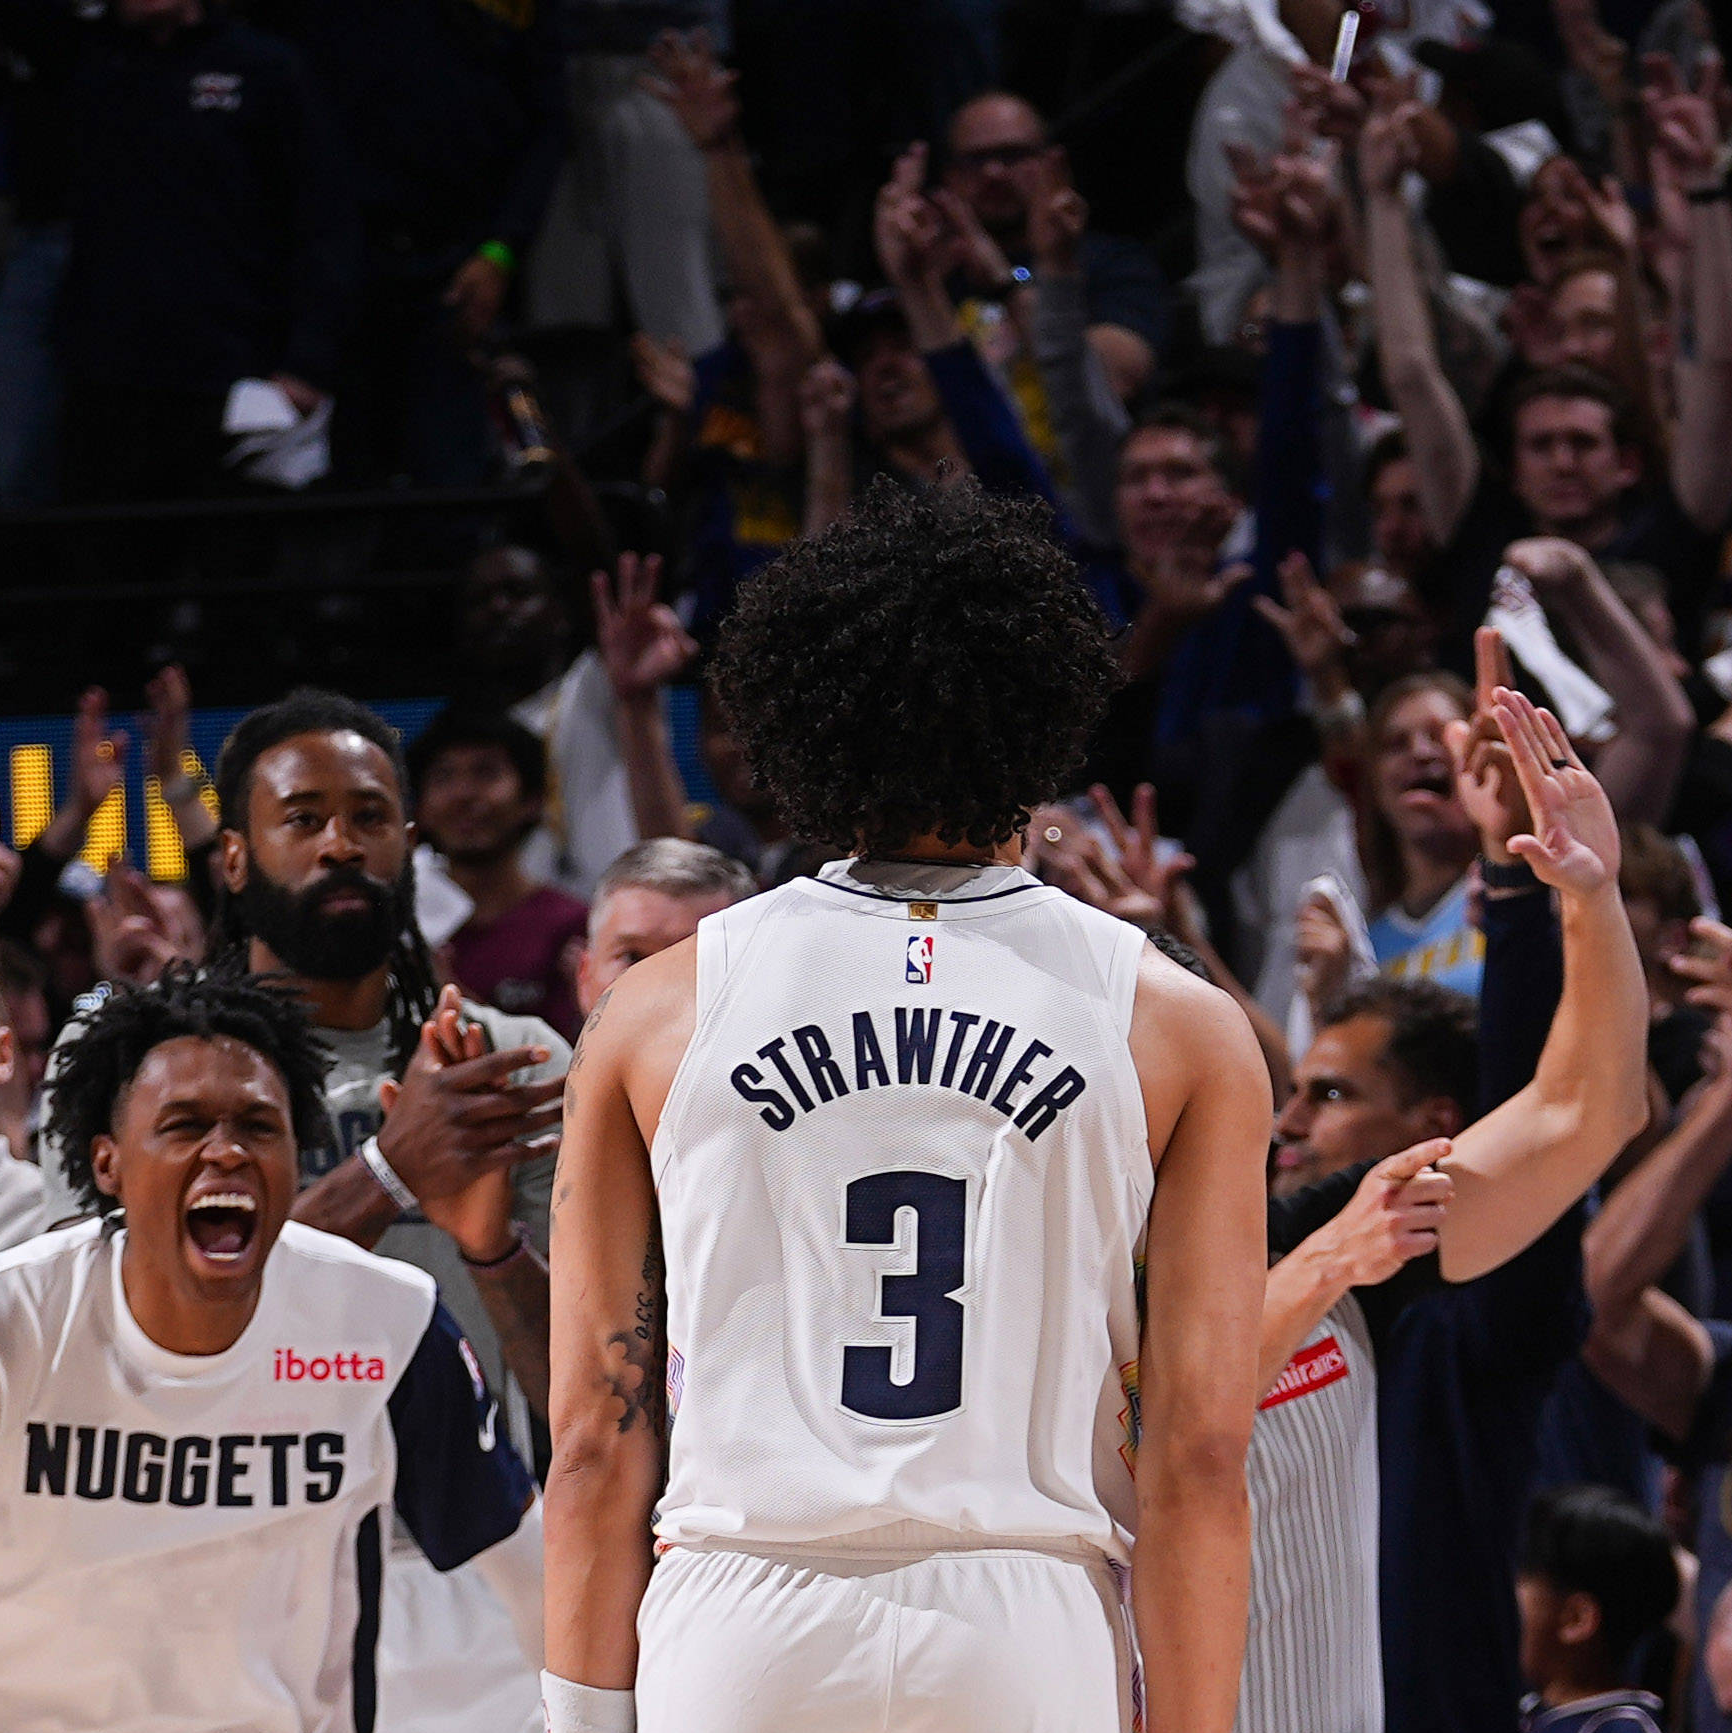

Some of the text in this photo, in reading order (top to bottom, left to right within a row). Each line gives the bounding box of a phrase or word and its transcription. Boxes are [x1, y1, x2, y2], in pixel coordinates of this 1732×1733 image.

[730, 1005, 1088, 1144] STRAWTHER
[840, 1169, 969, 1423] 3
[273, 1347, 385, 1383] ibotta
[24, 1421, 346, 1508] NUGGETS
